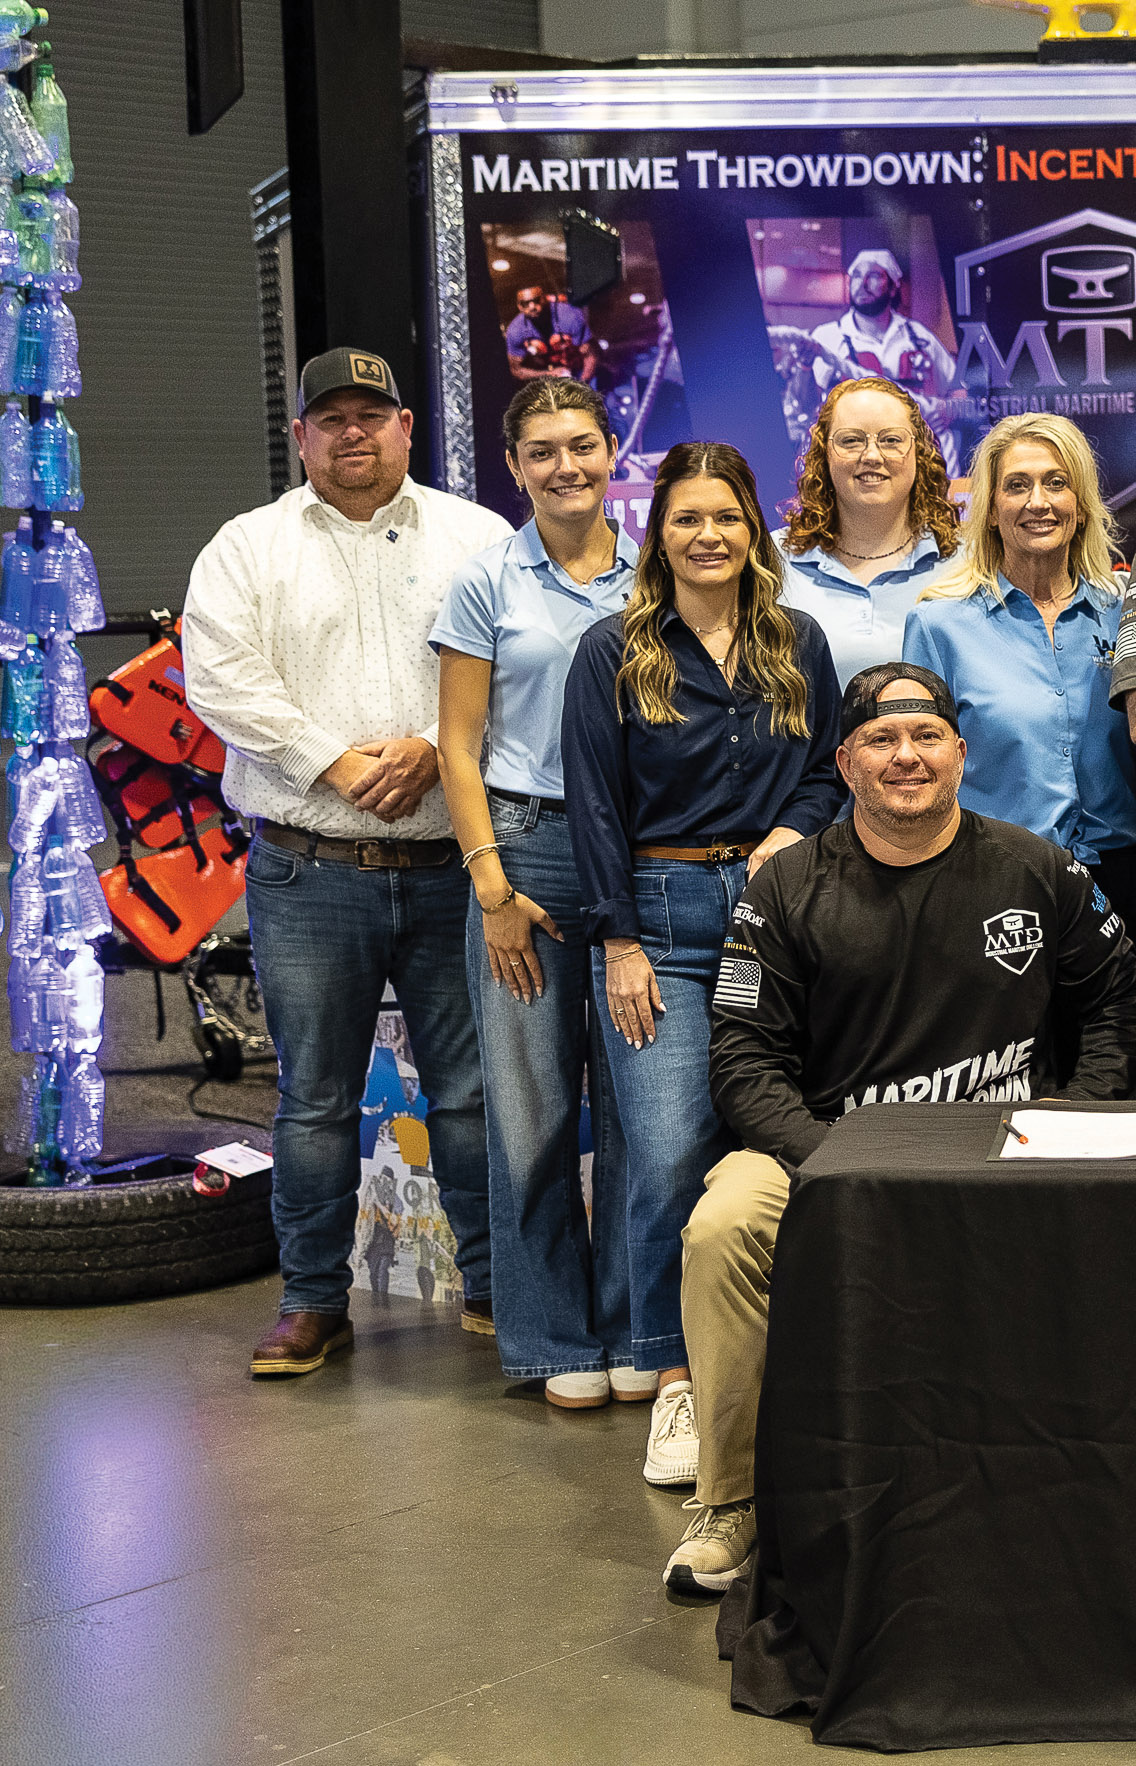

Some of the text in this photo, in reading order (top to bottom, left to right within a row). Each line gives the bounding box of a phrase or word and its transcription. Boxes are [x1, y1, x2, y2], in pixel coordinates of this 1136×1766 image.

[471, 153, 679, 193] MARITIME
[1055, 391, 1135, 415] MARITIME
[984, 927, 1044, 951] MTD
